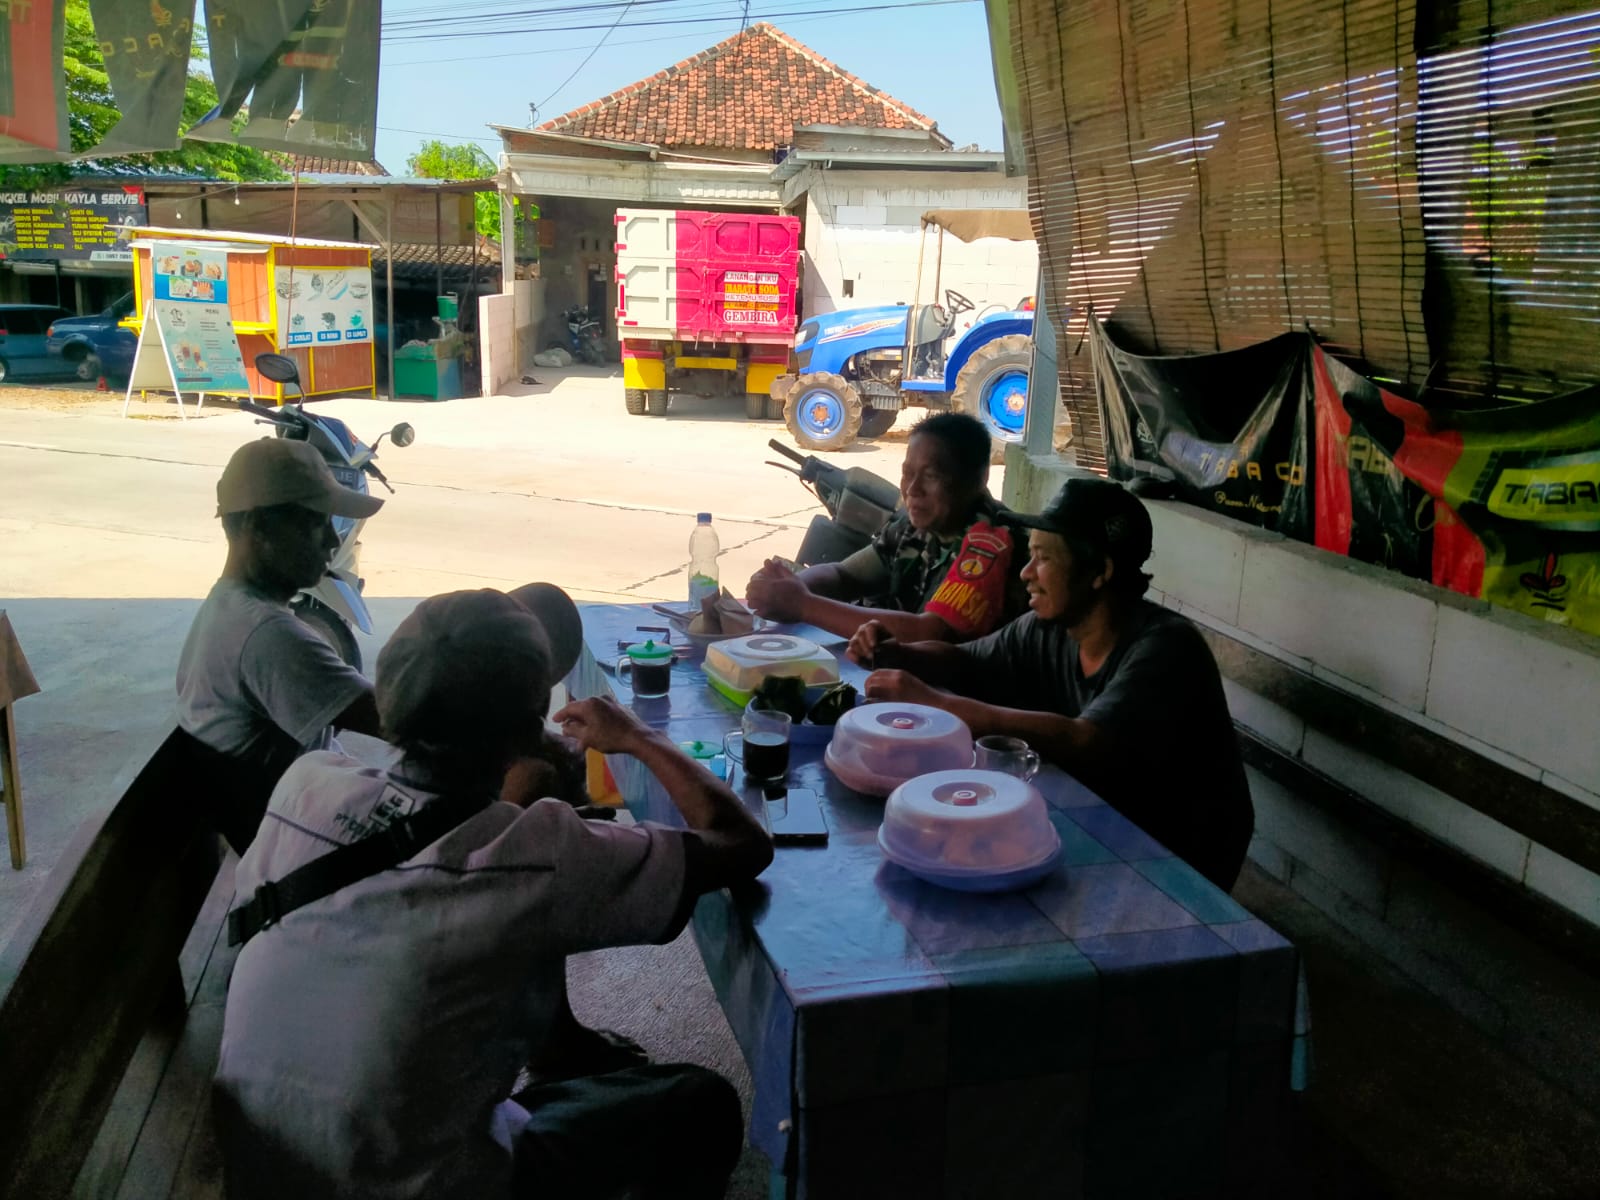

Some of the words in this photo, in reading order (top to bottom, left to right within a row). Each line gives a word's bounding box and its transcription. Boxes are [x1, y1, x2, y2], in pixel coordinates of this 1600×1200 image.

[64, 193, 97, 204] KAYLA
[101, 193, 138, 204] SERVIS
[724, 310, 776, 323] GEMBIRA
[1505, 481, 1600, 504] TABA
